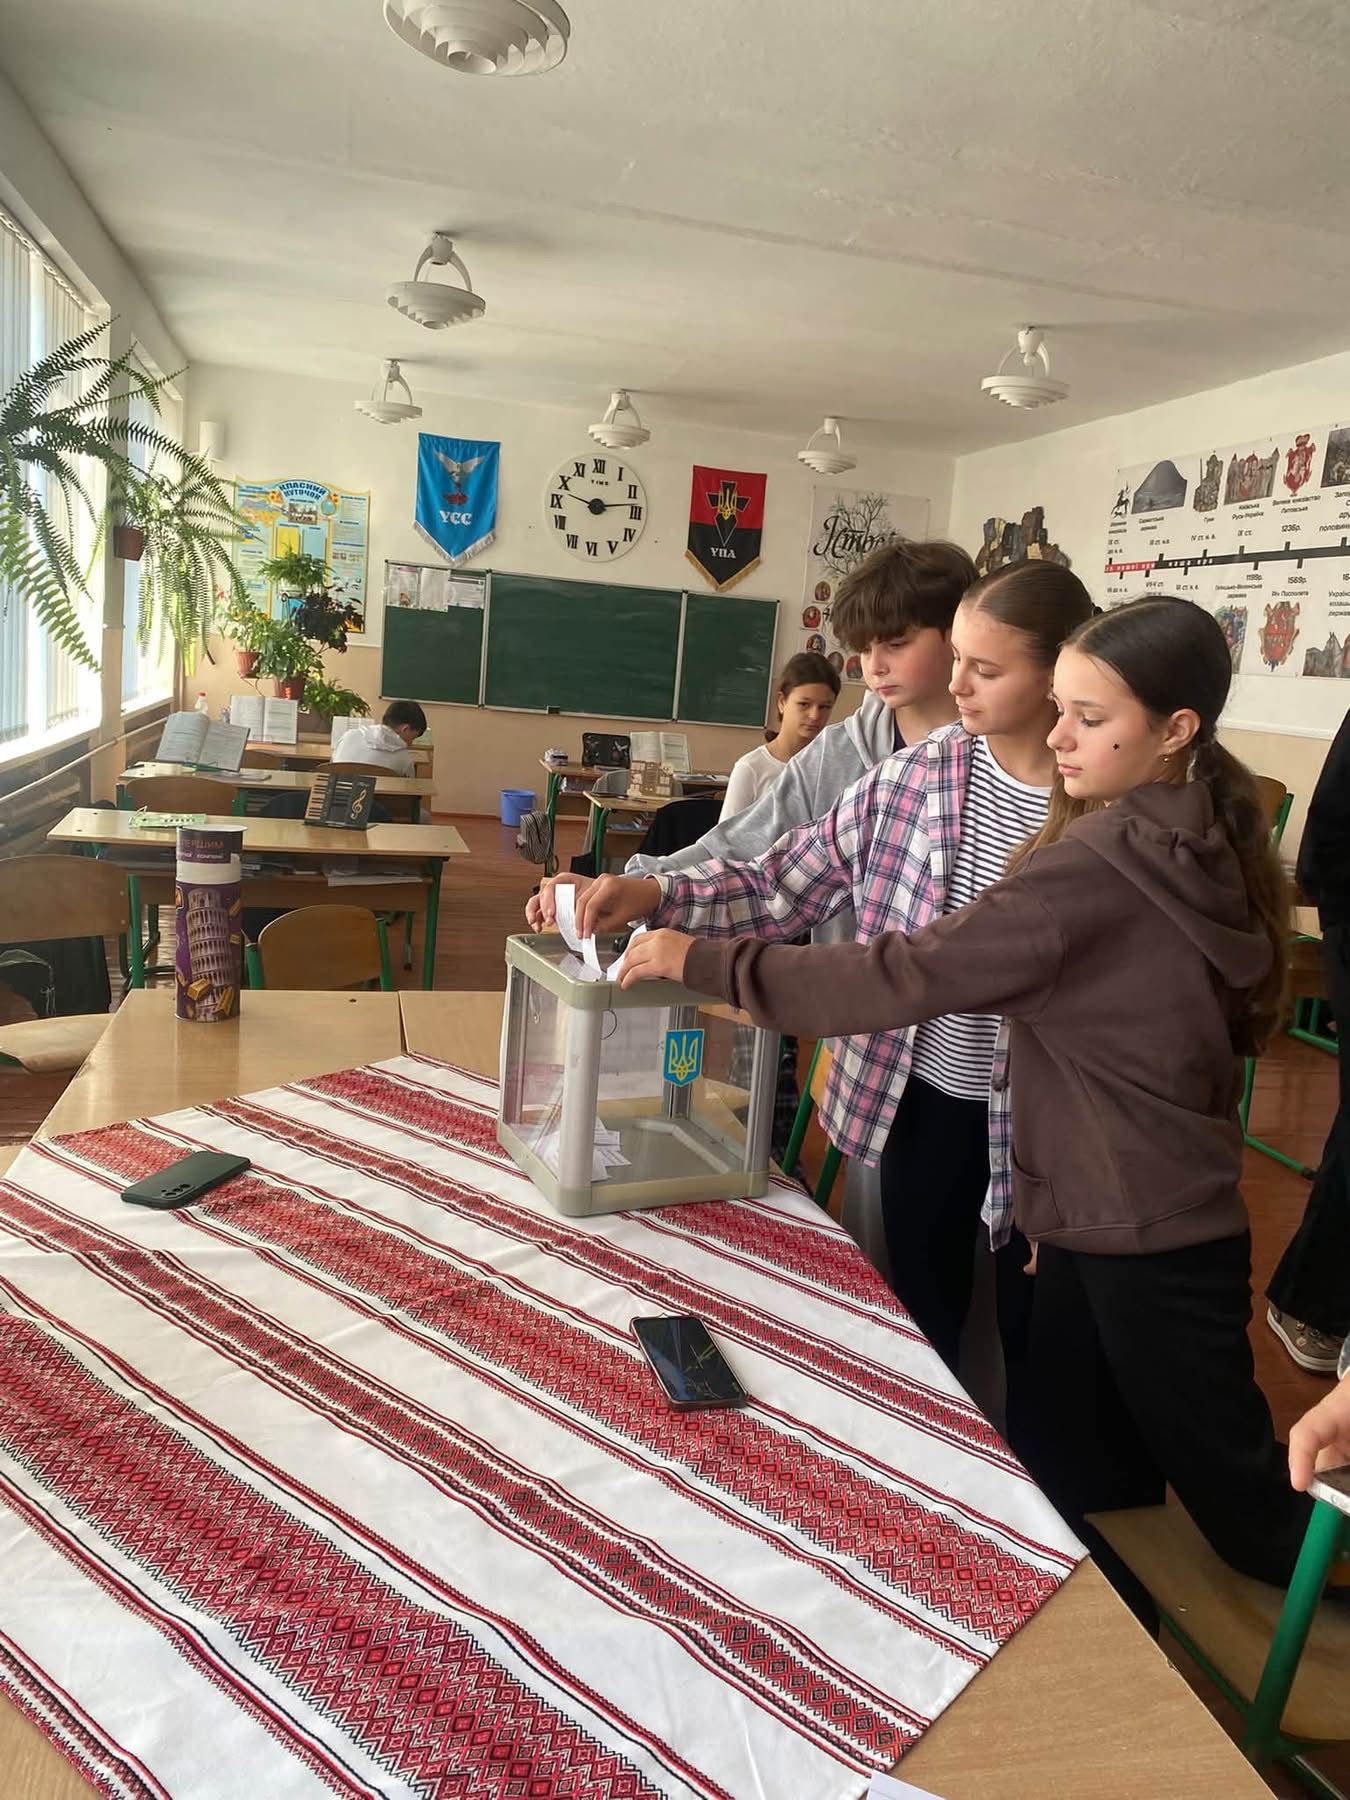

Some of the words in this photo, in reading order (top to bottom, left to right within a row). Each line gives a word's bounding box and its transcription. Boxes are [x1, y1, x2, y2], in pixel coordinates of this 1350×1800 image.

[573, 462, 586, 478] XI
[592, 459, 606, 474] XII
[618, 467, 624, 481] I
[558, 475, 572, 491] X
[283, 489, 321, 500] КУТОЧОК
[628, 484, 638, 499] II
[550, 494, 563, 509] IX
[440, 510, 473, 525] УСС
[629, 506, 642, 520] III
[566, 534, 579, 549] VII
[623, 528, 636, 542] IV
[586, 541, 598, 556] VI
[607, 541, 619, 554] V
[710, 547, 736, 559] УПА
